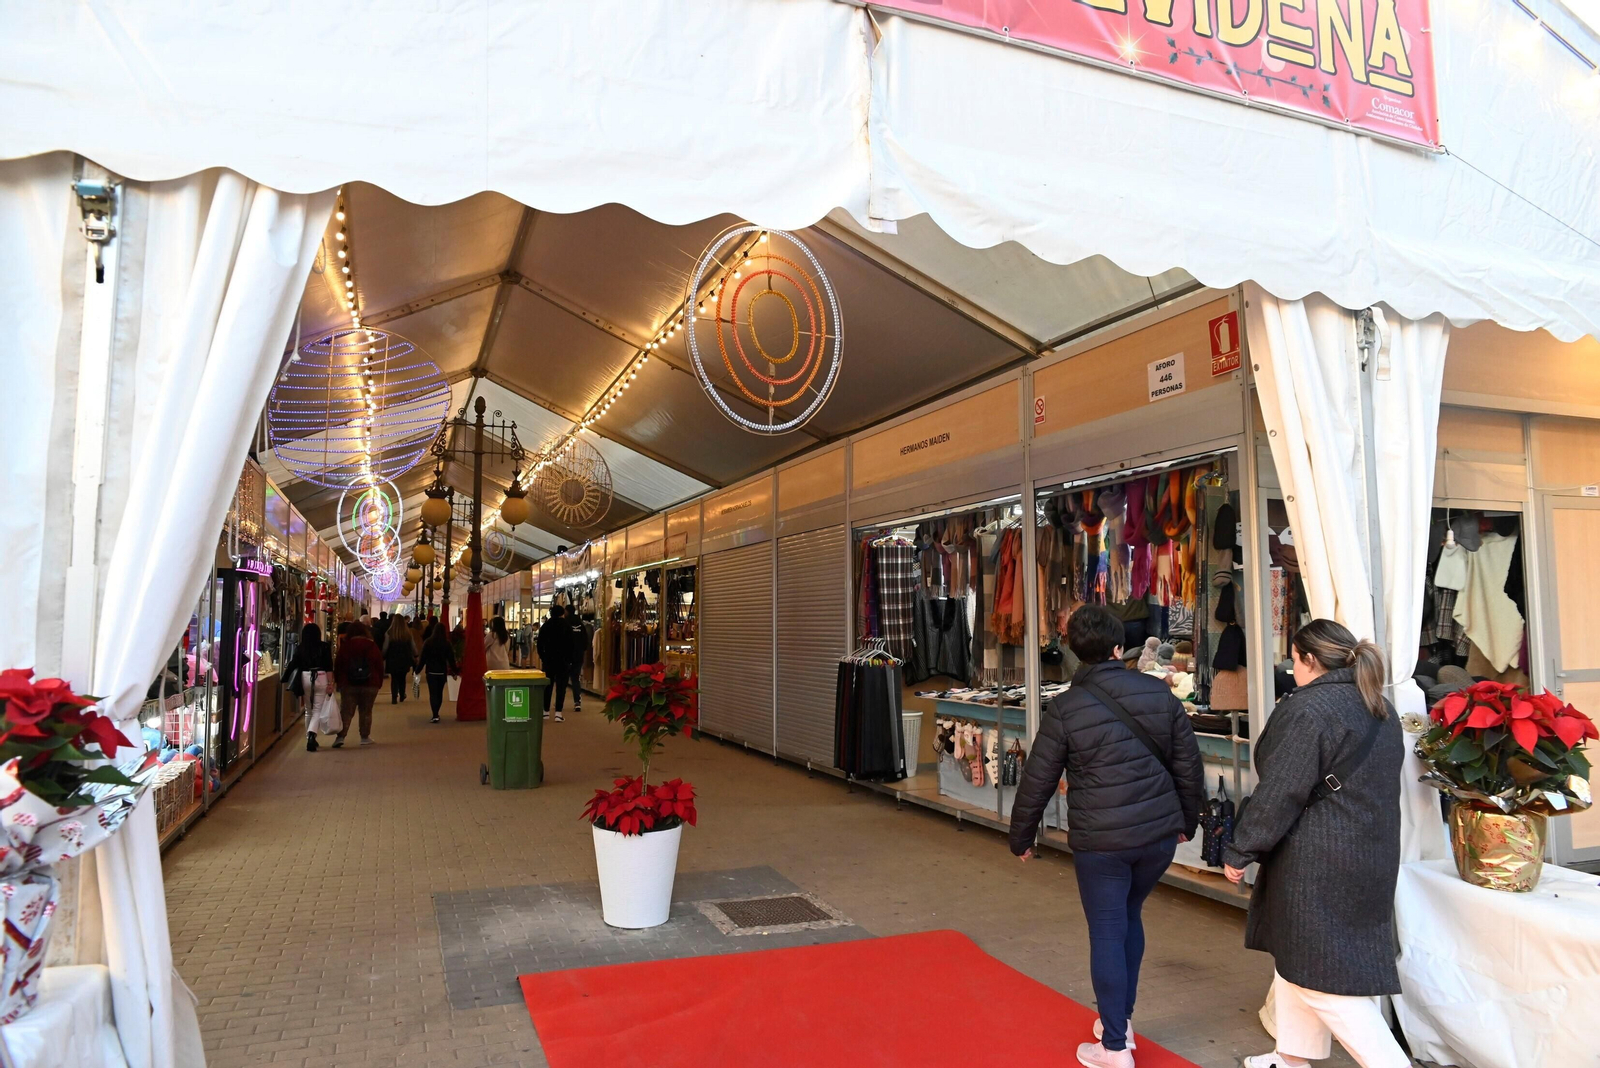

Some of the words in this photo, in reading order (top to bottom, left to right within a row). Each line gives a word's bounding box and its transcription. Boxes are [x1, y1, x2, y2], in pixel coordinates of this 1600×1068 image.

[1371, 97, 1415, 119] Comacor
[1155, 359, 1176, 372] AFORO
[1213, 356, 1239, 372] EXTINTOR
[1159, 372, 1173, 383] 446
[1151, 382, 1183, 398] PERSONAS
[900, 439, 928, 456] HERMANOS
[929, 432, 951, 447] MAIDEN
